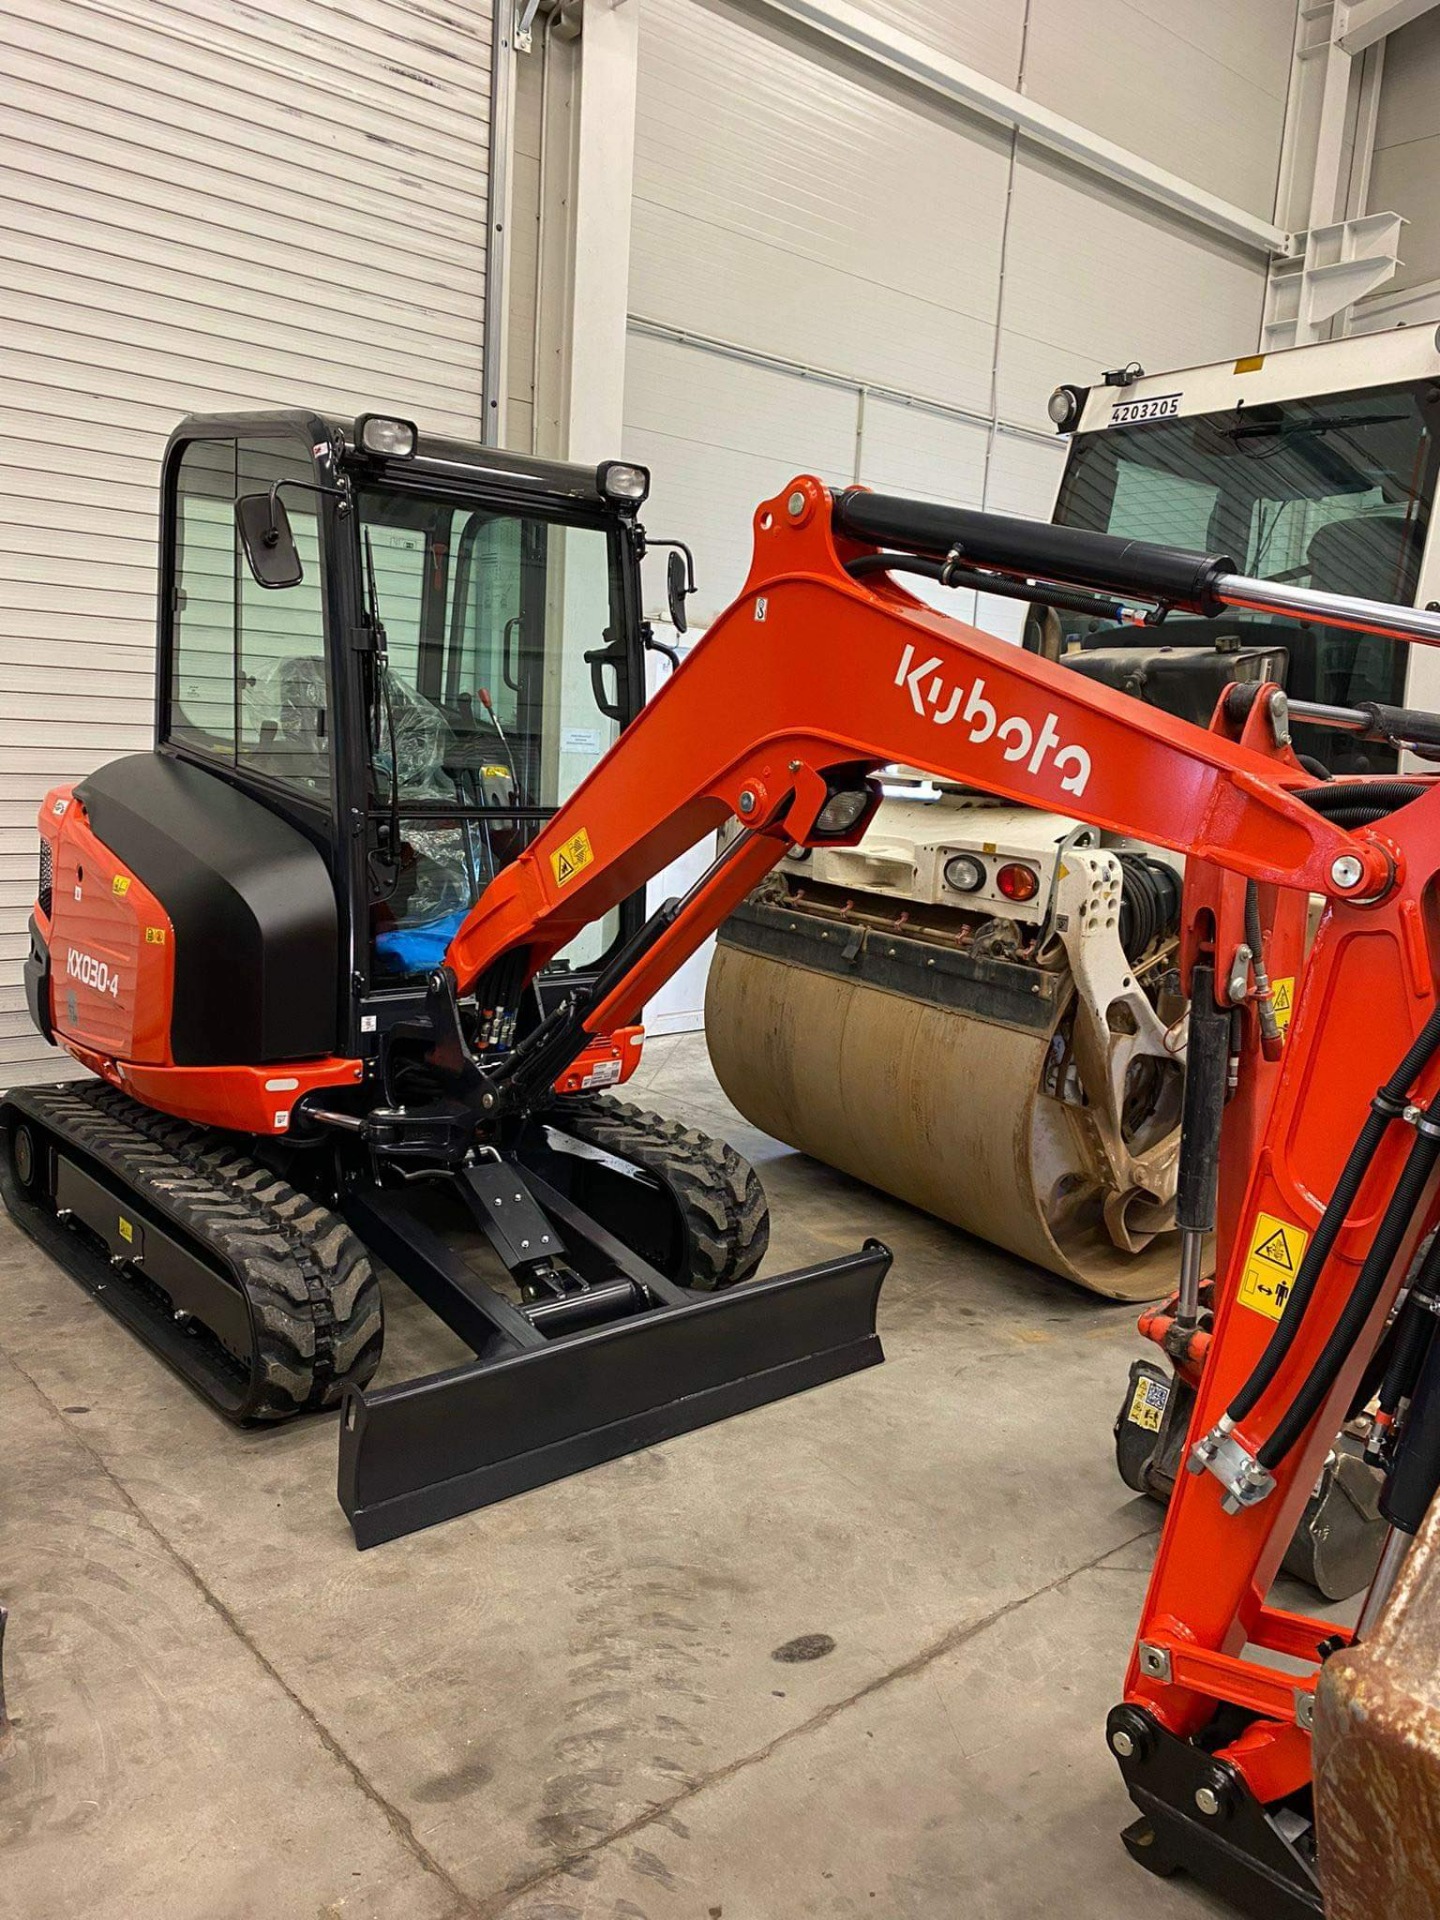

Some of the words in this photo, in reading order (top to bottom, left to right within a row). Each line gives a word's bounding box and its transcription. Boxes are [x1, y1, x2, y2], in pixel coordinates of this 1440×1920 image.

[1112, 399, 1179, 422] 4203205
[894, 643, 1091, 798] Kubota
[67, 947, 119, 998] KX030-4
